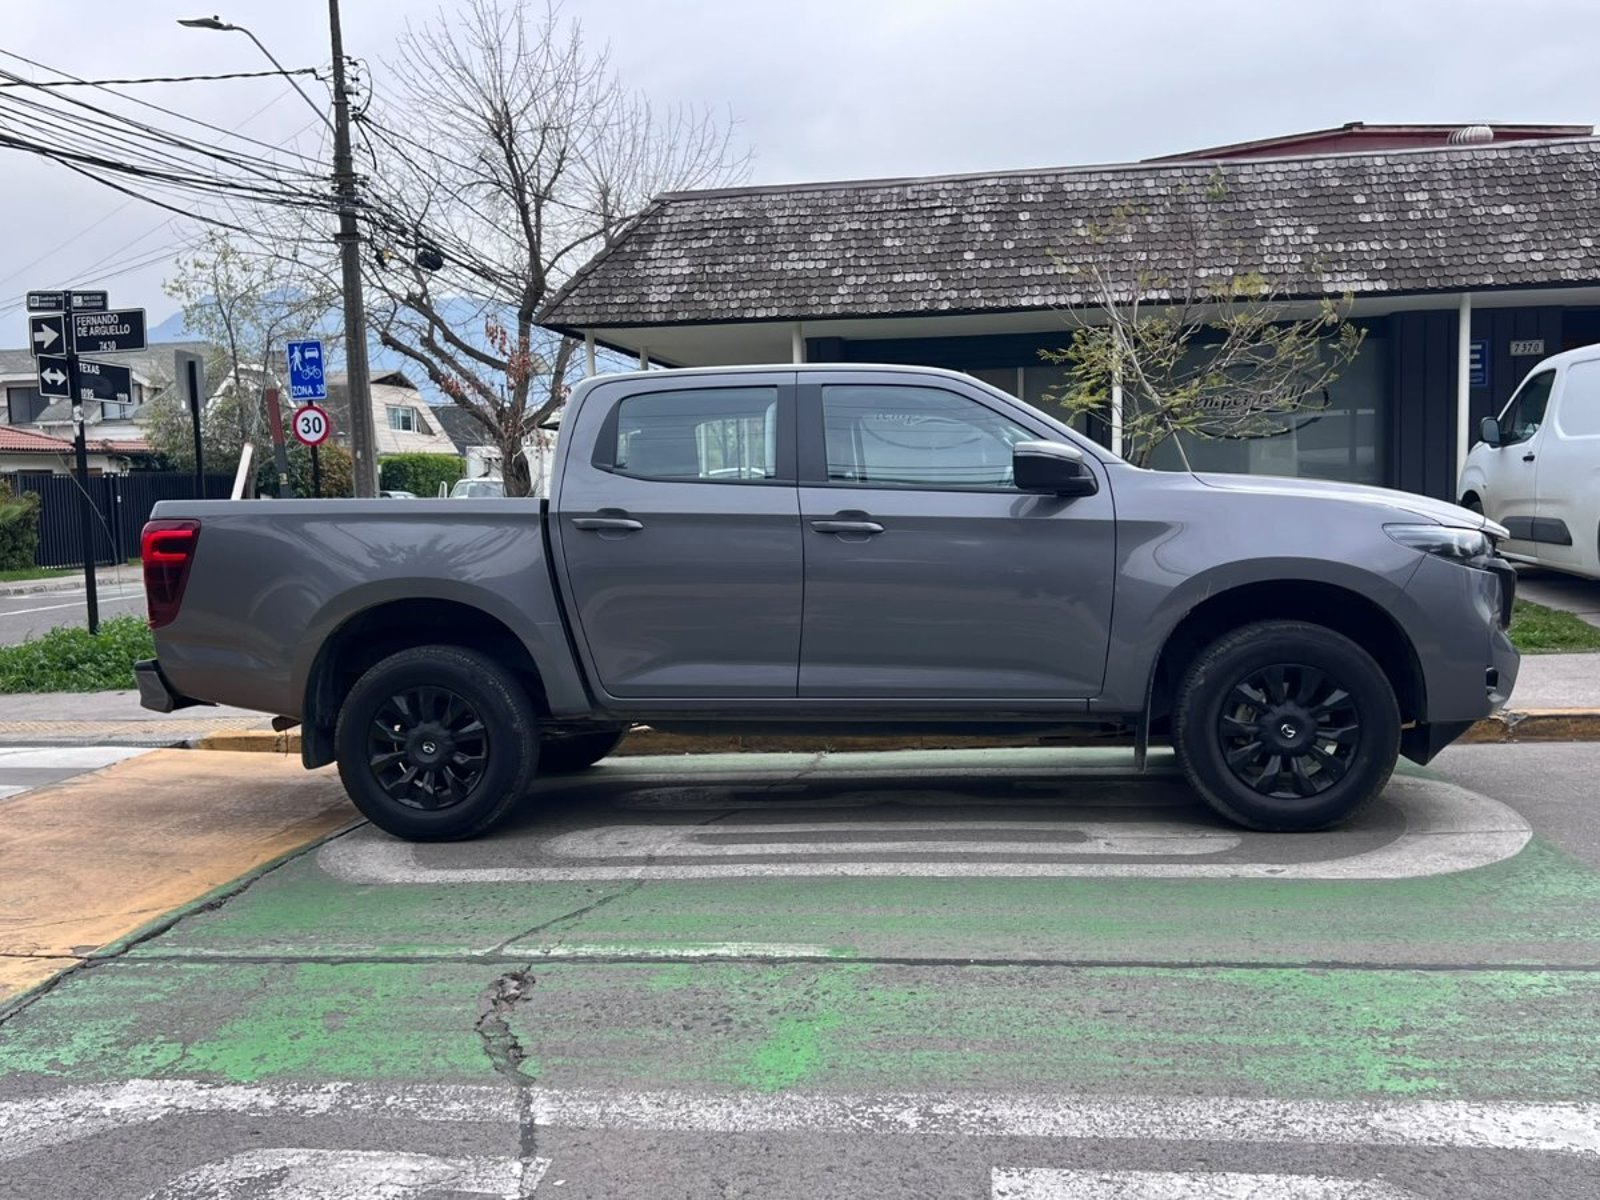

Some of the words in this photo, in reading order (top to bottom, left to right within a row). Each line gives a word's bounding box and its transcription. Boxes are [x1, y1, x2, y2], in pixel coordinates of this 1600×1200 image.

[76, 314, 119, 327] FERNANDO
[77, 327, 89, 337] DE
[89, 324, 130, 337] ARGUELLO
[79, 362, 100, 375] TEXAS
[292, 385, 314, 397] ZONA
[301, 416, 322, 434] 30
